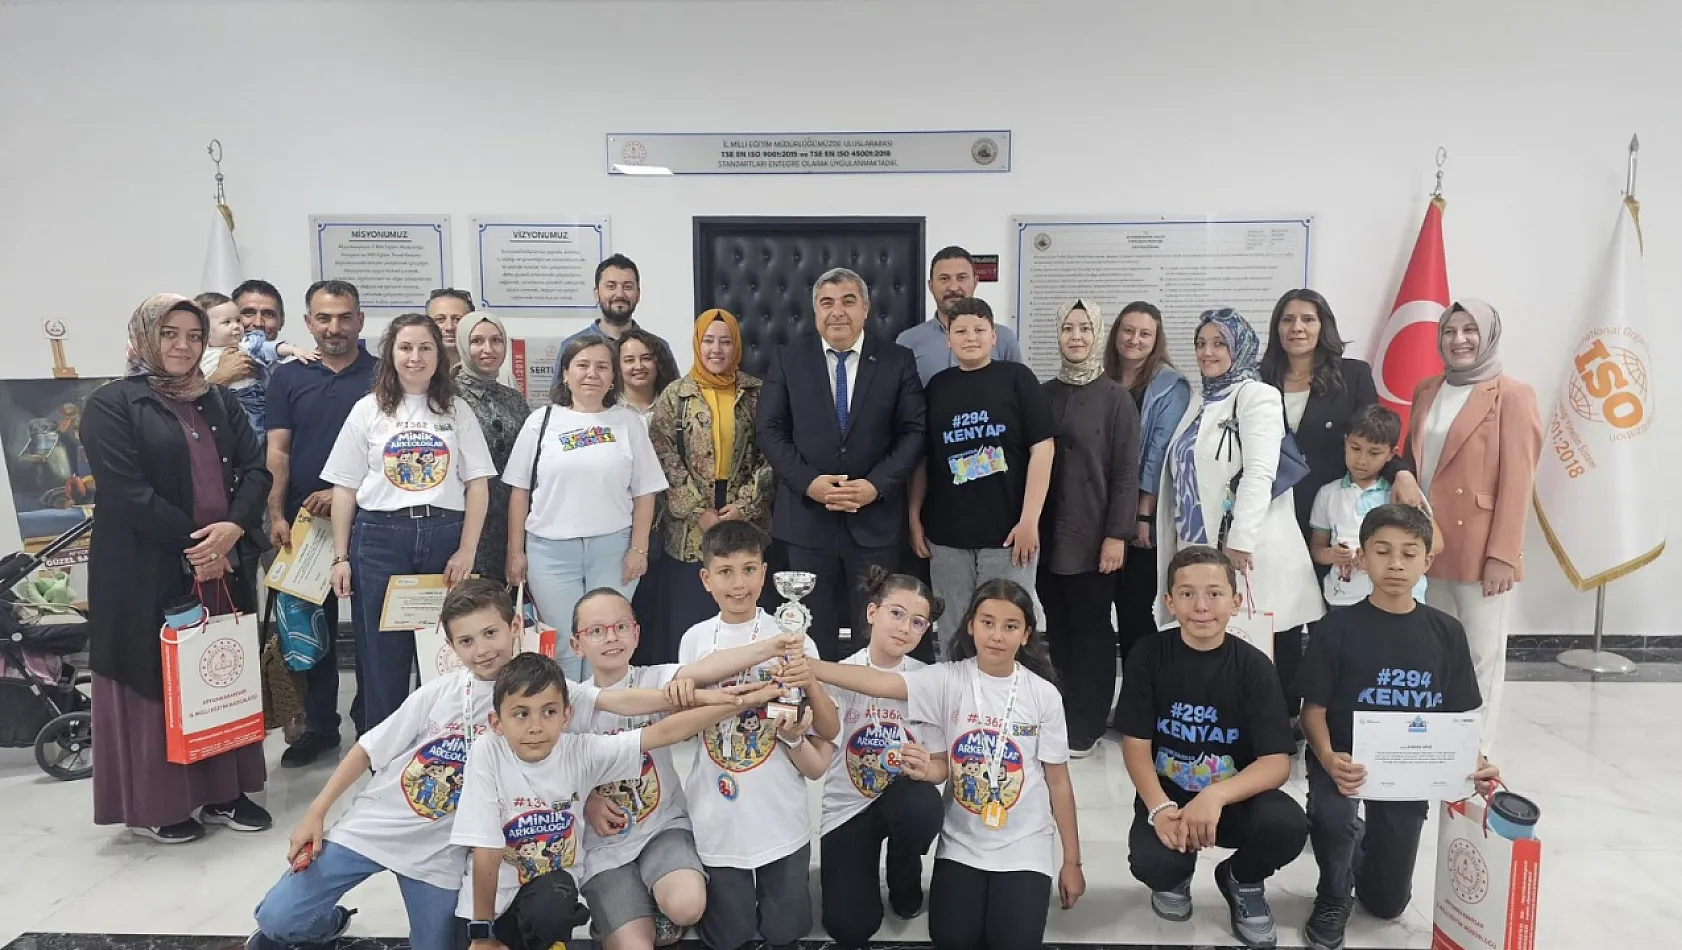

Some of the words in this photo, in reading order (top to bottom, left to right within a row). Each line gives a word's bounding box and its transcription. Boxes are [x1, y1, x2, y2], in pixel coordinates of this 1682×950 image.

[851, 149, 892, 157] 45001:2018
[351, 229, 408, 239] MİSYONUMUZ
[512, 230, 569, 240] VİZYONUMUZ
[529, 365, 554, 374] SERTİ
[1574, 338, 1644, 430] ISO
[952, 409, 989, 428] #294
[942, 424, 1007, 444] KENYAP
[1551, 420, 1586, 480] 01:2018
[1376, 667, 1433, 689] #294
[1169, 701, 1219, 724] #294
[1156, 716, 1241, 745] KENYAP
